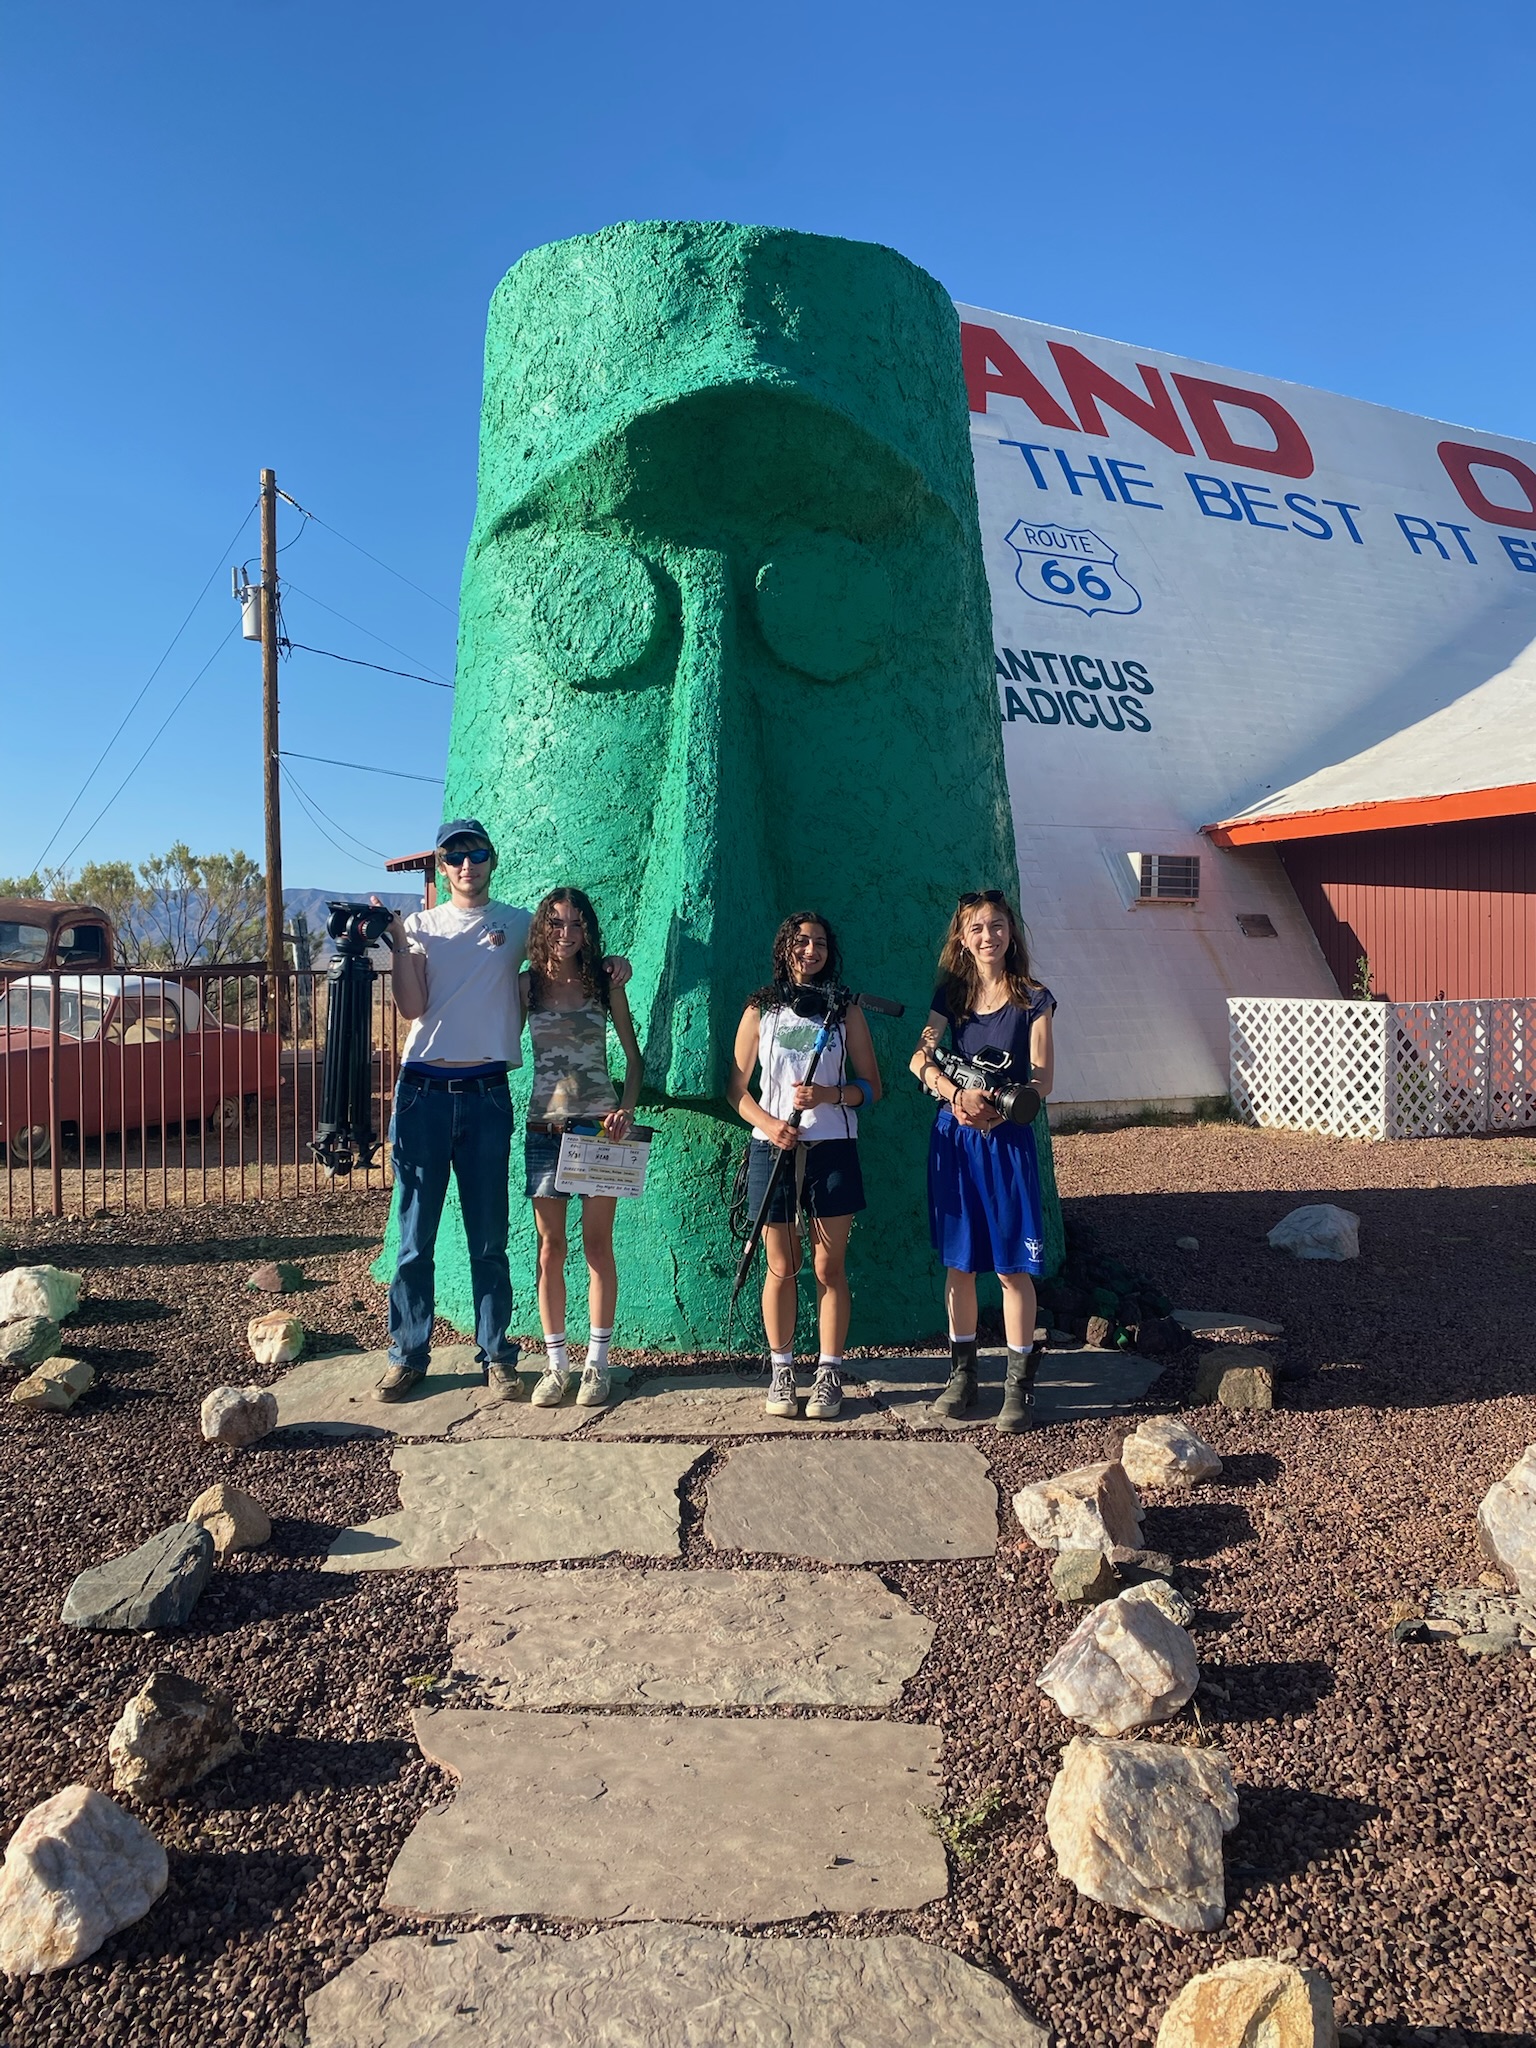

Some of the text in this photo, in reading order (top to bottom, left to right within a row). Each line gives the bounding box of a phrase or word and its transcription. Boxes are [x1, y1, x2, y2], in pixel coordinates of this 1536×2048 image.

[961, 322, 1315, 479] AND
[999, 439, 1536, 573] THE BEST RT 6
[1023, 527, 1094, 554] ROUTE
[1041, 559, 1112, 601] 66
[1001, 686, 1152, 733] ADICUS
